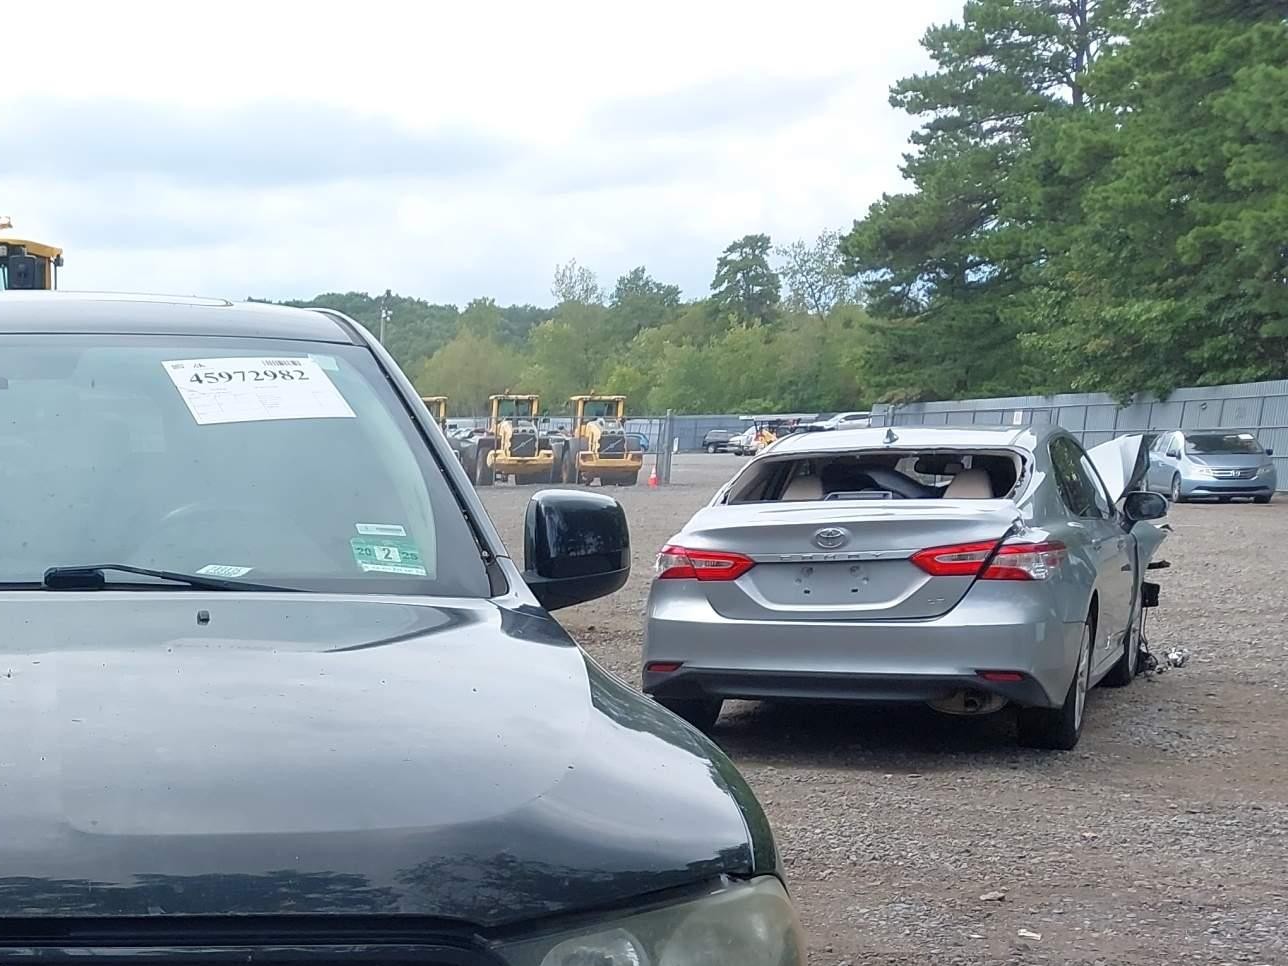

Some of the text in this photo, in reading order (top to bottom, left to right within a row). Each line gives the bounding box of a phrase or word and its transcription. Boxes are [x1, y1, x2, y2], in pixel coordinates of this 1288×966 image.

[190, 369, 310, 384] 45972982
[355, 547, 372, 556] 20
[382, 547, 393, 560] 2
